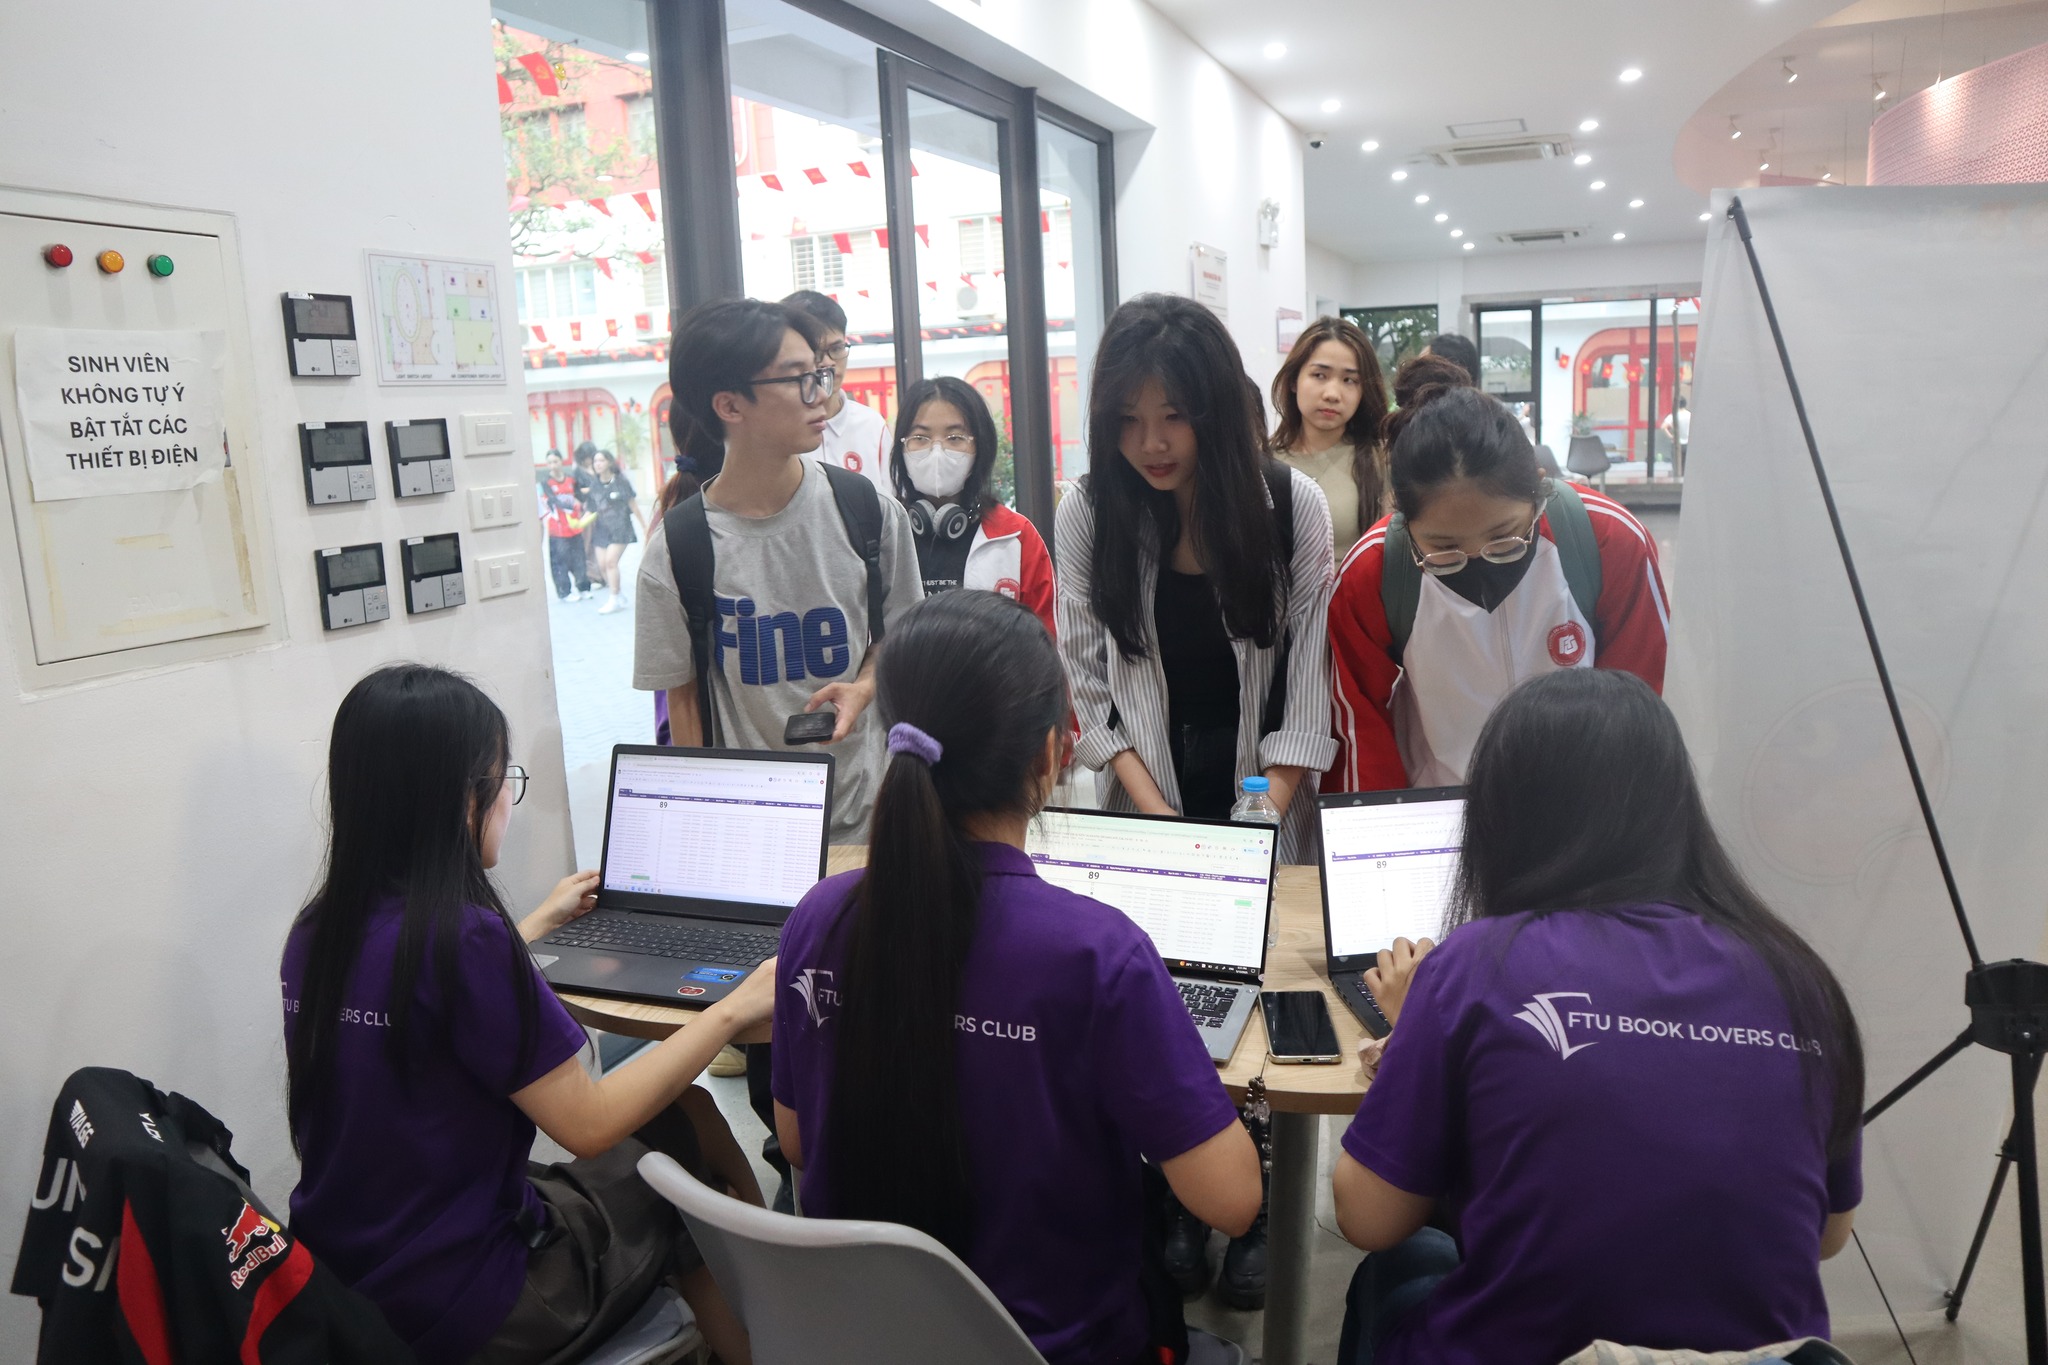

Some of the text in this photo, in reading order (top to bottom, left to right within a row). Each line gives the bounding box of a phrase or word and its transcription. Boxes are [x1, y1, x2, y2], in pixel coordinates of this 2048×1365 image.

[68, 352, 170, 373] SINH VIÊN
[61, 382, 185, 406] KHÔNG TỰ Ý
[70, 412, 188, 441] BẬT TẮT CÁC
[66, 444, 199, 470] THIẾT BỊ ĐIỆN
[713, 597, 850, 686] Fine
[659, 801, 668, 809] 89
[1087, 871, 1100, 880] 89
[1376, 860, 1387, 869] 89
[981, 1019, 1037, 1042] CLUB
[1568, 1011, 1611, 1031] FTU
[1618, 1016, 1685, 1040] BOOK
[1688, 1023, 1775, 1047] LOVERS
